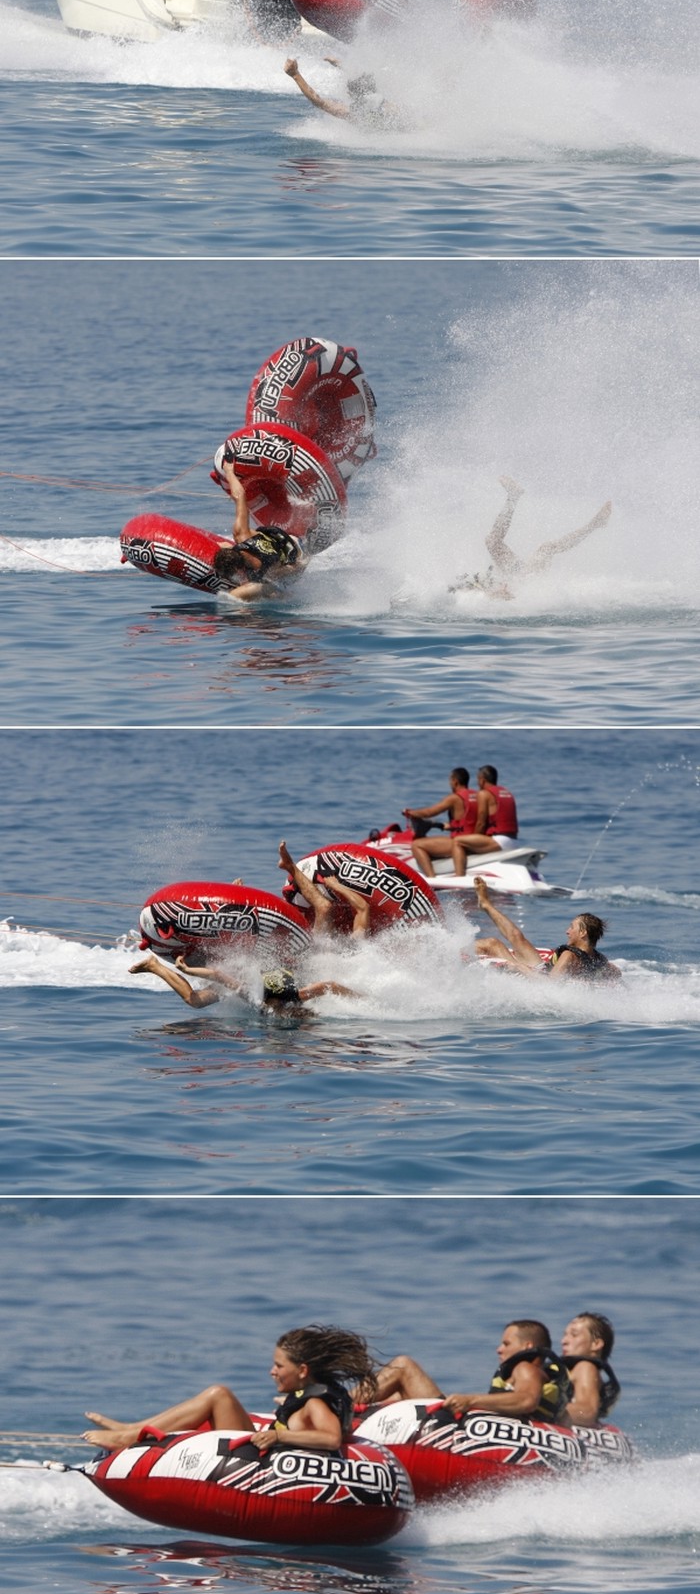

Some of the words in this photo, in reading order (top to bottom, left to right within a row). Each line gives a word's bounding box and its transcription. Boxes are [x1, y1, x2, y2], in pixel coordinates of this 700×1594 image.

[259, 350, 303, 410] OBRIEN
[340, 861, 410, 902] OBRIEN
[177, 912, 254, 932] OBRIEN
[466, 1417, 583, 1462] OBRIEN
[273, 1451, 393, 1492] OBRIEN
